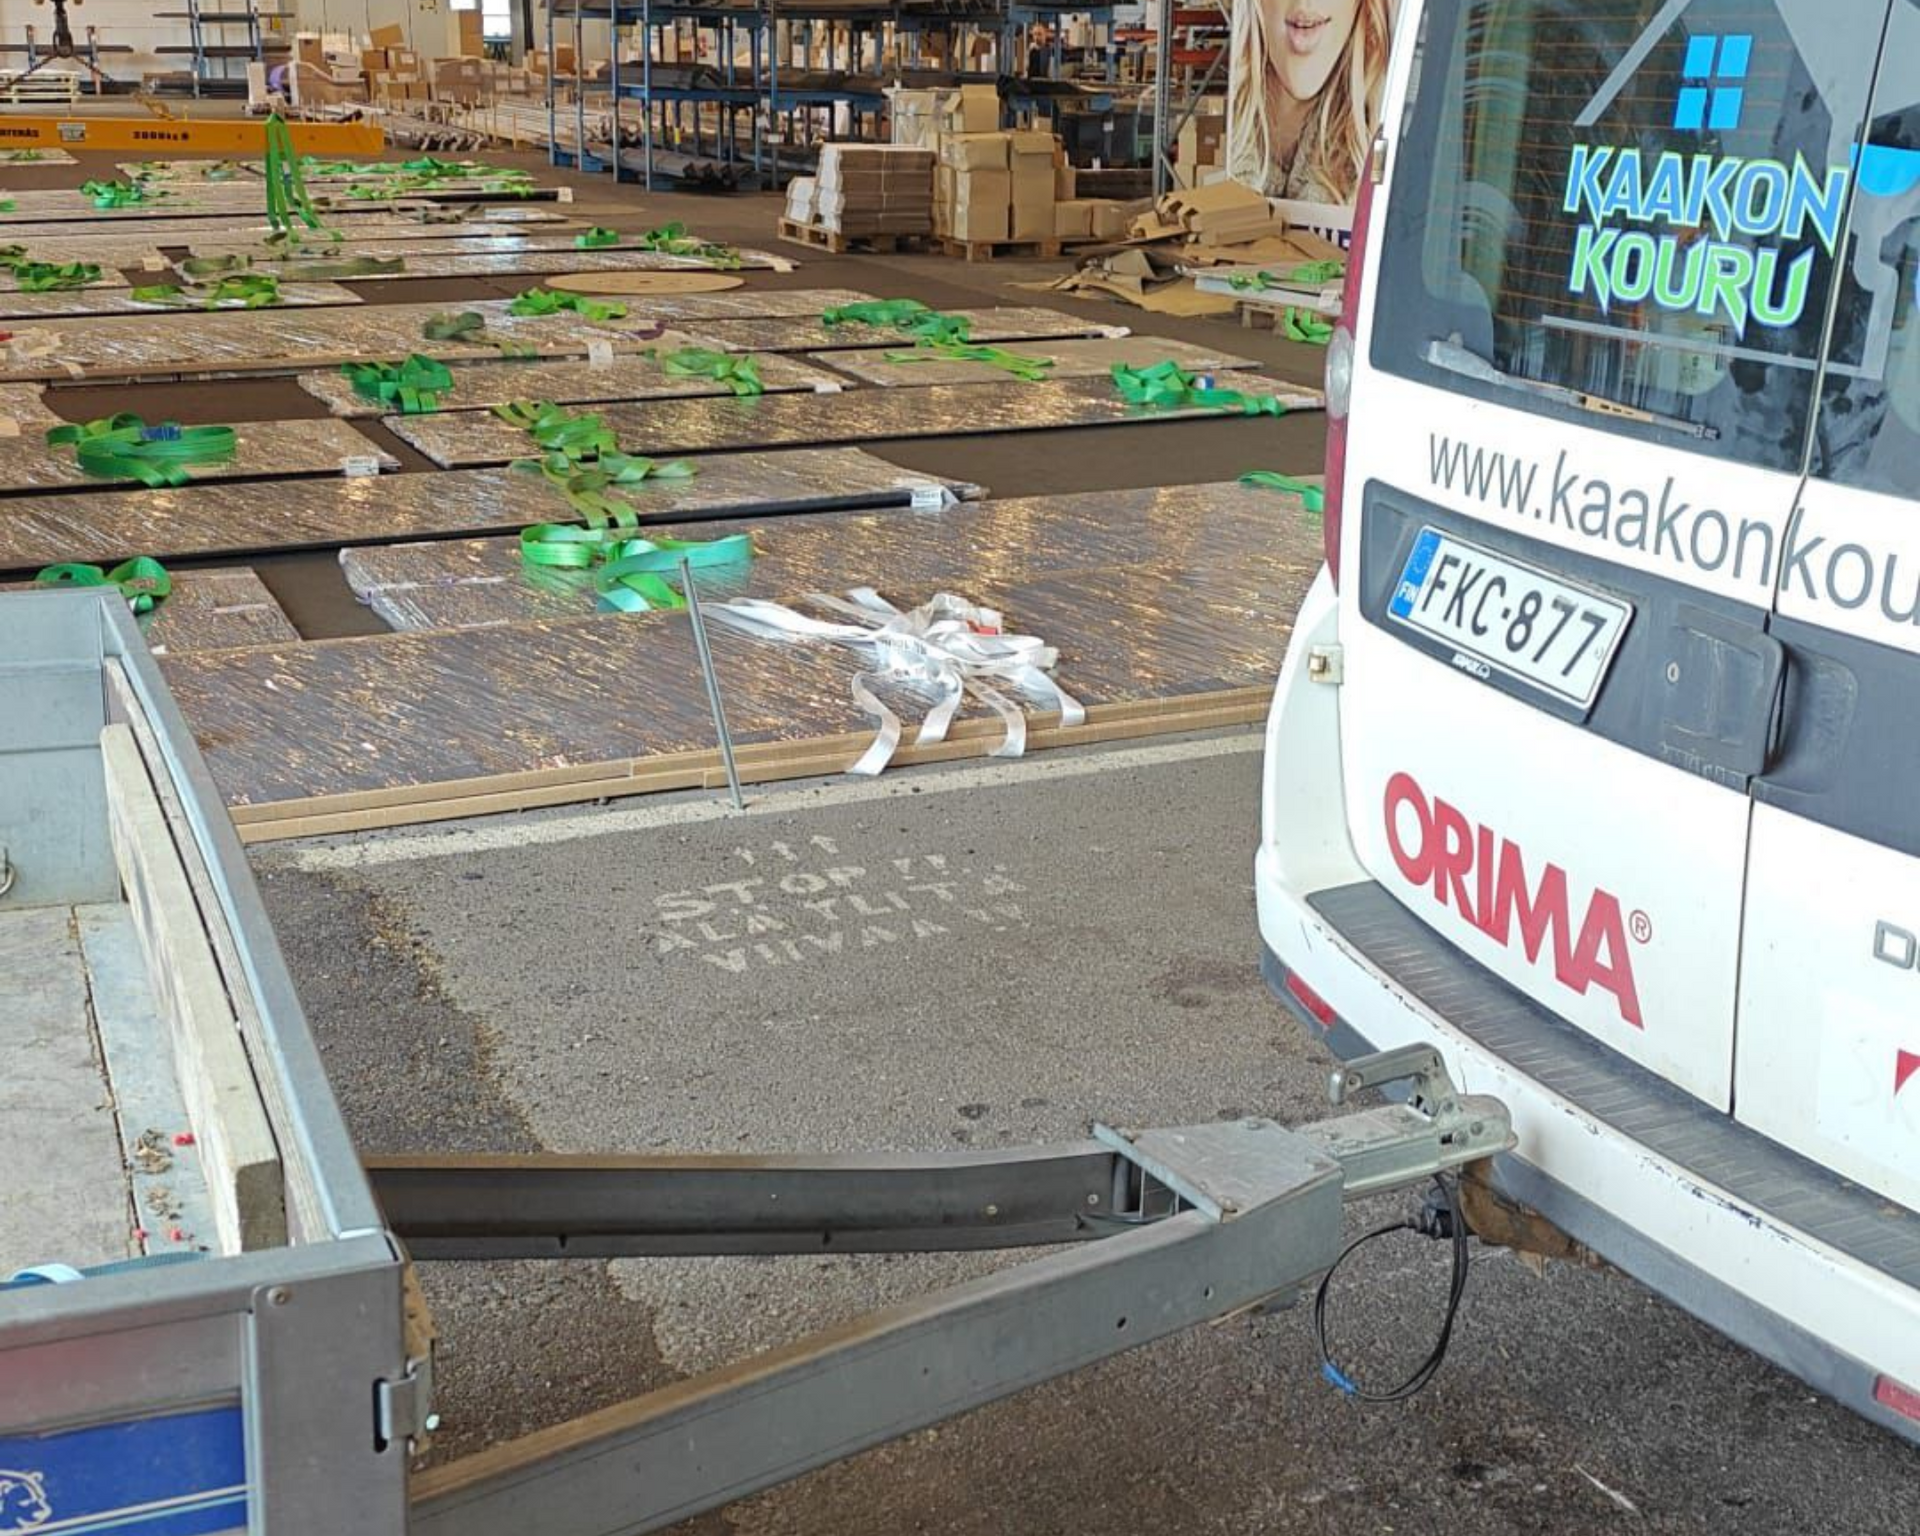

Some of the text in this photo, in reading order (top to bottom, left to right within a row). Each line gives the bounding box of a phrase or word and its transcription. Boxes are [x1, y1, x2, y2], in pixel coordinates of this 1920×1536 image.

[1563, 144, 1849, 259] KAAKON
[1568, 223, 1815, 341] KOURU
[1421, 553, 1608, 677] FKC-877
[653, 867, 866, 921] STOP
[1384, 771, 1645, 1031] ORIMA
